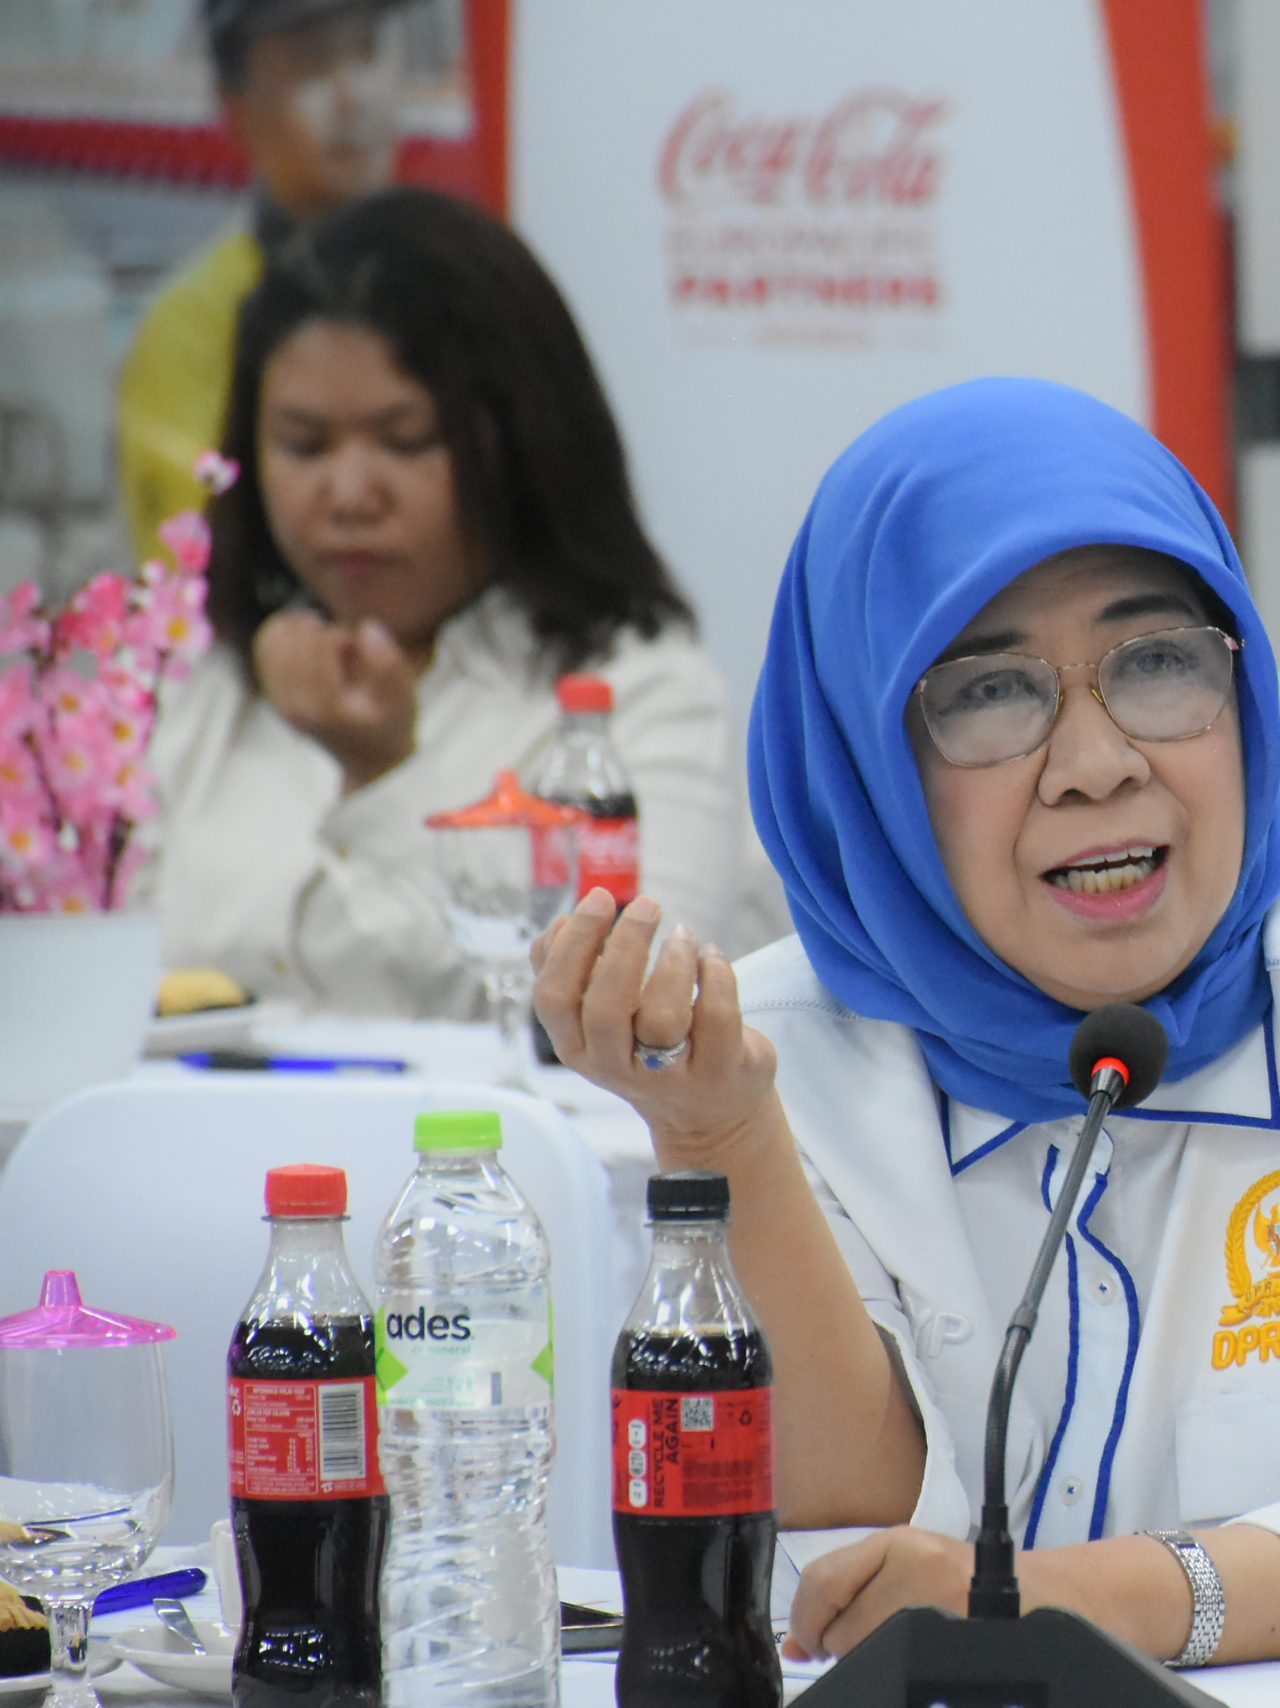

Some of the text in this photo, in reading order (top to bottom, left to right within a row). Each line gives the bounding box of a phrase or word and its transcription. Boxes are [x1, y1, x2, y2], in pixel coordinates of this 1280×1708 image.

[386, 1305, 472, 1340] ades
[653, 1398, 665, 1508] RECYCLE ME
[665, 1398, 680, 1465] AGAIN
